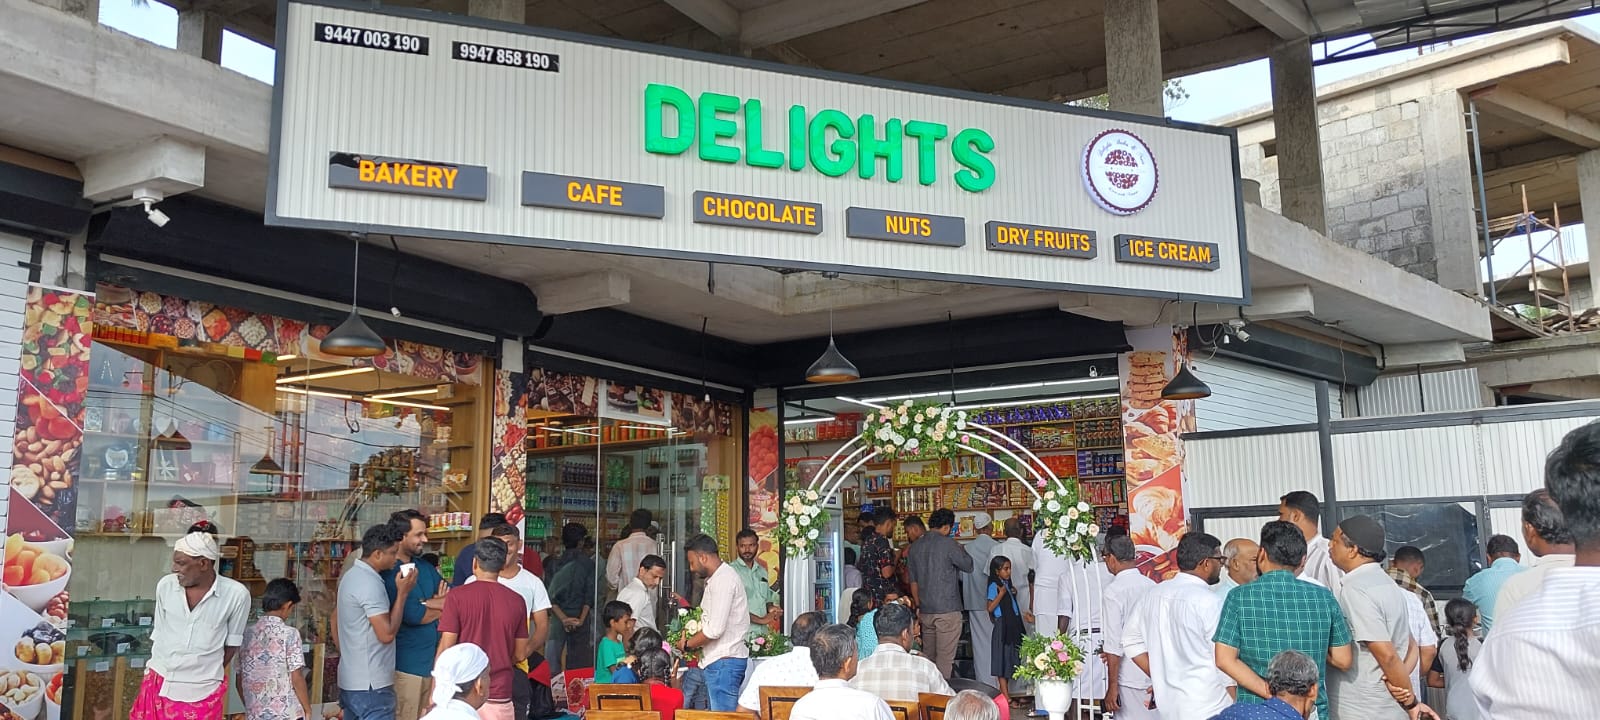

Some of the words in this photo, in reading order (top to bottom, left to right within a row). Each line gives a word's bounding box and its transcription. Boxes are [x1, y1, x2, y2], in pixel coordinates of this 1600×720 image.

[324, 25, 361, 44] 9447
[363, 30, 391, 48] 003
[394, 34, 420, 52] 190
[460, 43, 494, 62] 9947
[496, 48, 522, 65] 858
[525, 52, 550, 69] 190
[644, 83, 997, 193] DELIGHTS
[358, 159, 458, 189] BAKERY
[566, 181, 623, 207] CAFE
[702, 195, 816, 226] CHOCOLATE
[885, 214, 932, 237] NUTS
[997, 225, 1030, 246] DRY
[1033, 229, 1091, 252] FRUITS
[1128, 239, 1154, 258] ICE
[1158, 242, 1212, 263] CREAM
